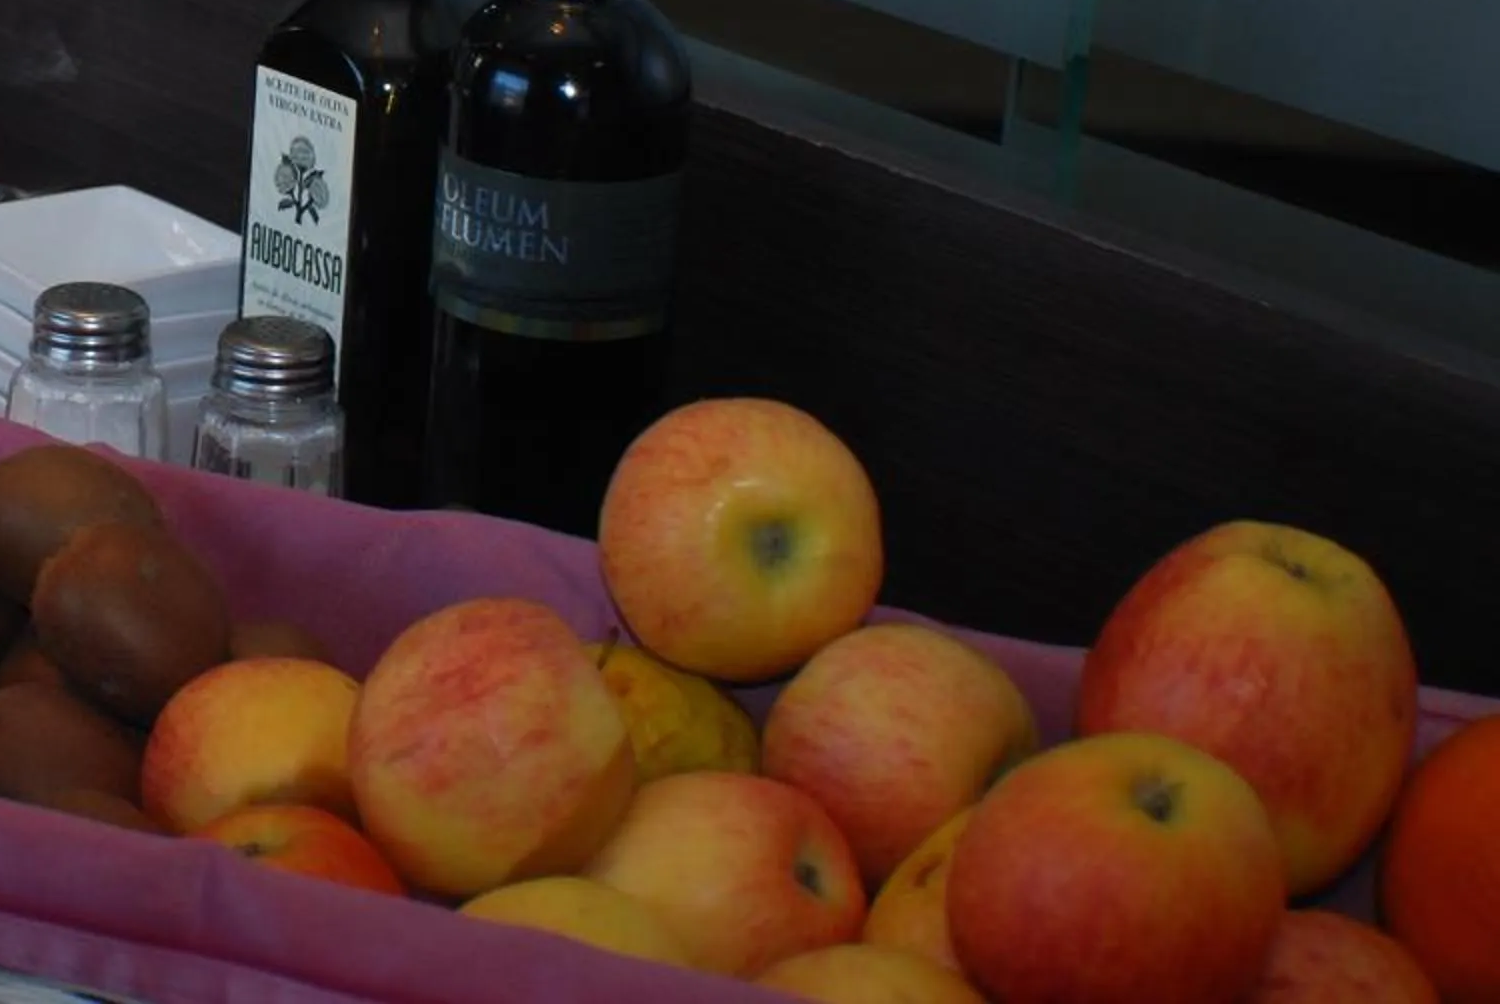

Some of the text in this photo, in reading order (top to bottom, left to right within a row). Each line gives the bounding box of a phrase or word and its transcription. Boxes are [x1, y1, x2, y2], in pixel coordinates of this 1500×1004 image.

[310, 110, 342, 132] EXTRA
[443, 172, 549, 230] OLEUM
[250, 221, 343, 294] AUBOCASSA
[440, 203, 570, 265] FLUMEN
